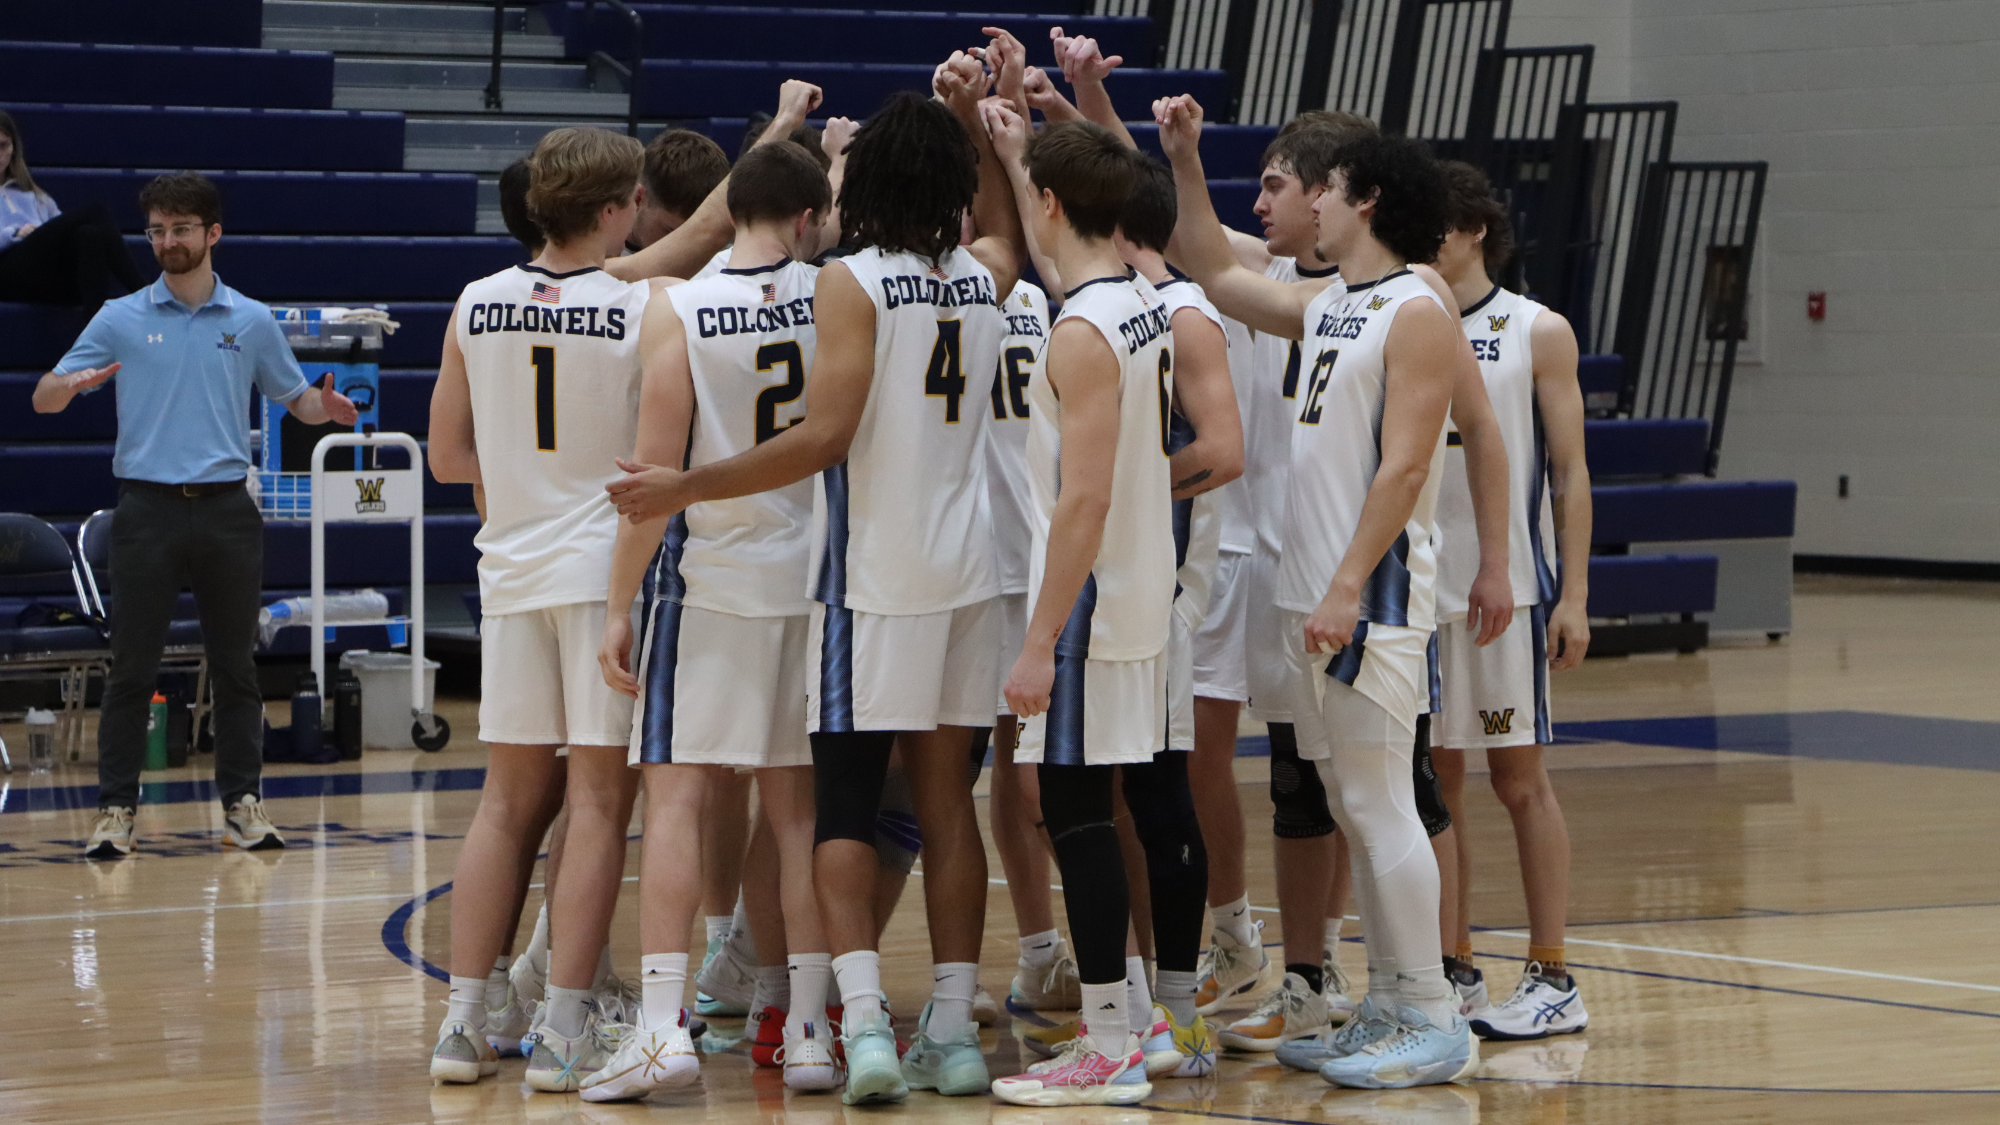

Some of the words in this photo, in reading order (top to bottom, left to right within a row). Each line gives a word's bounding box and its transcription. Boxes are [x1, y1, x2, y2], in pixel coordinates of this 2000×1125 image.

[881, 275, 997, 310] COLONELS
[1366, 294, 1394, 311] W
[469, 303, 625, 341] COLONELS
[1006, 314, 1044, 338] KES
[1488, 314, 1511, 332] W
[1470, 338, 1501, 362] ES
[925, 318, 967, 424] 4
[530, 344, 557, 452] 1
[754, 339, 806, 446] 2
[1298, 348, 1339, 427] 12
[355, 477, 385, 501] W
[355, 501, 386, 513] WILKES
[1479, 708, 1515, 735] W
